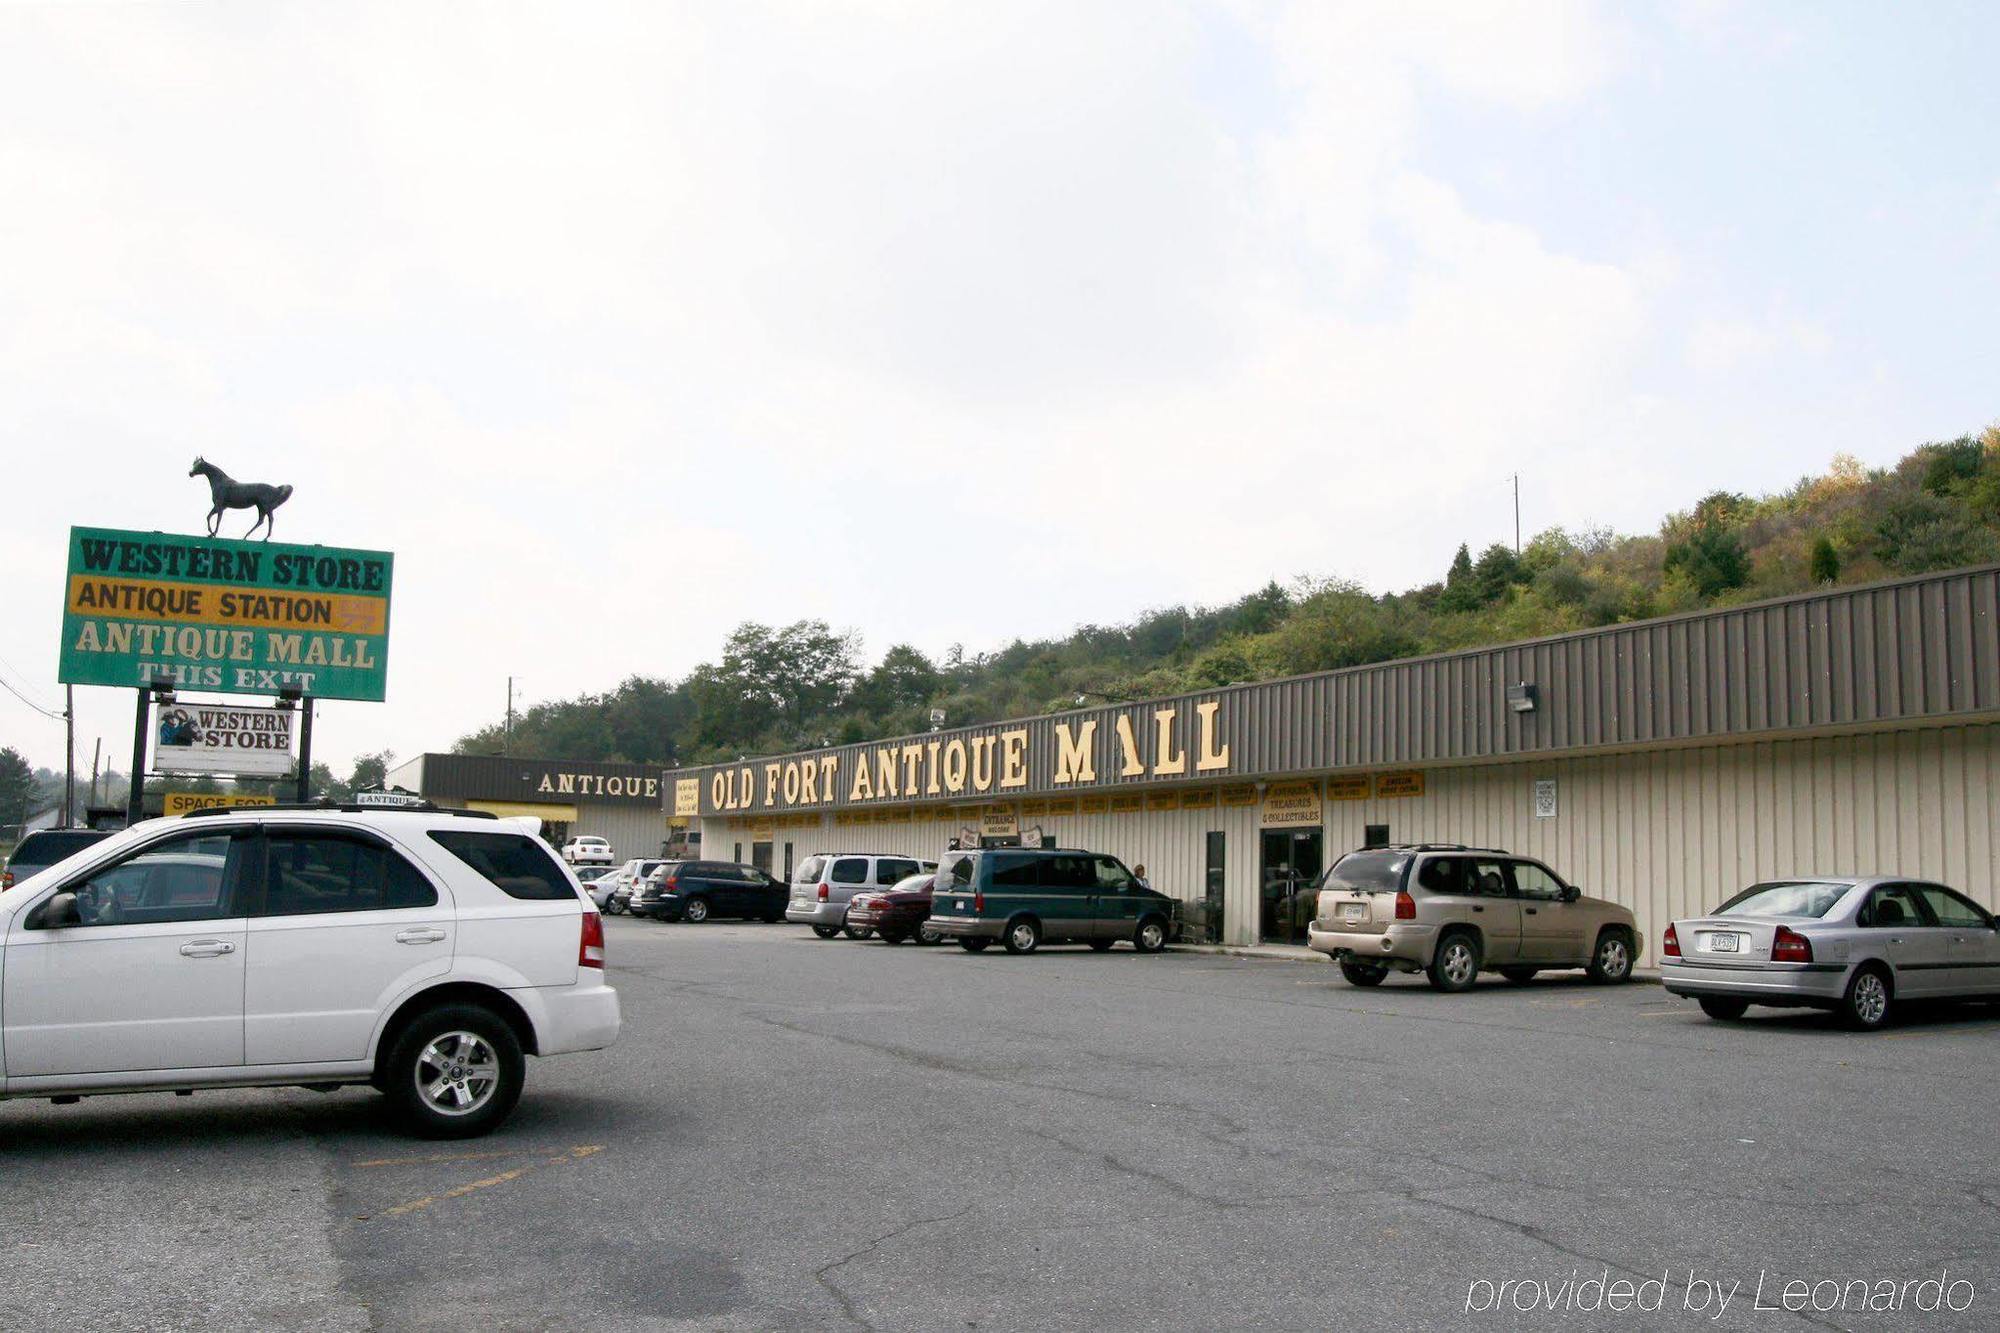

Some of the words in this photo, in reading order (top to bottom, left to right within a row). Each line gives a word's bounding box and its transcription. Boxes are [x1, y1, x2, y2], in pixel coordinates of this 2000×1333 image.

[80, 538, 263, 583] WESTERN
[273, 554, 385, 592] STORE
[77, 582, 203, 616] ANTIQUE
[219, 591, 333, 625] STATION
[75, 620, 255, 662] ANTIQUE
[266, 632, 376, 669] MALL
[137, 662, 223, 688] THIS
[234, 667, 317, 692] EXIT
[198, 710, 291, 732] WESTERN
[205, 730, 290, 750] STORE
[712, 768, 754, 810] OLD
[765, 755, 838, 806] FORT
[849, 729, 1027, 801] ANTIQUE
[1054, 702, 1229, 783] MALL
[538, 772, 658, 798] ANTIQUE
[172, 796, 227, 810] SPACE
